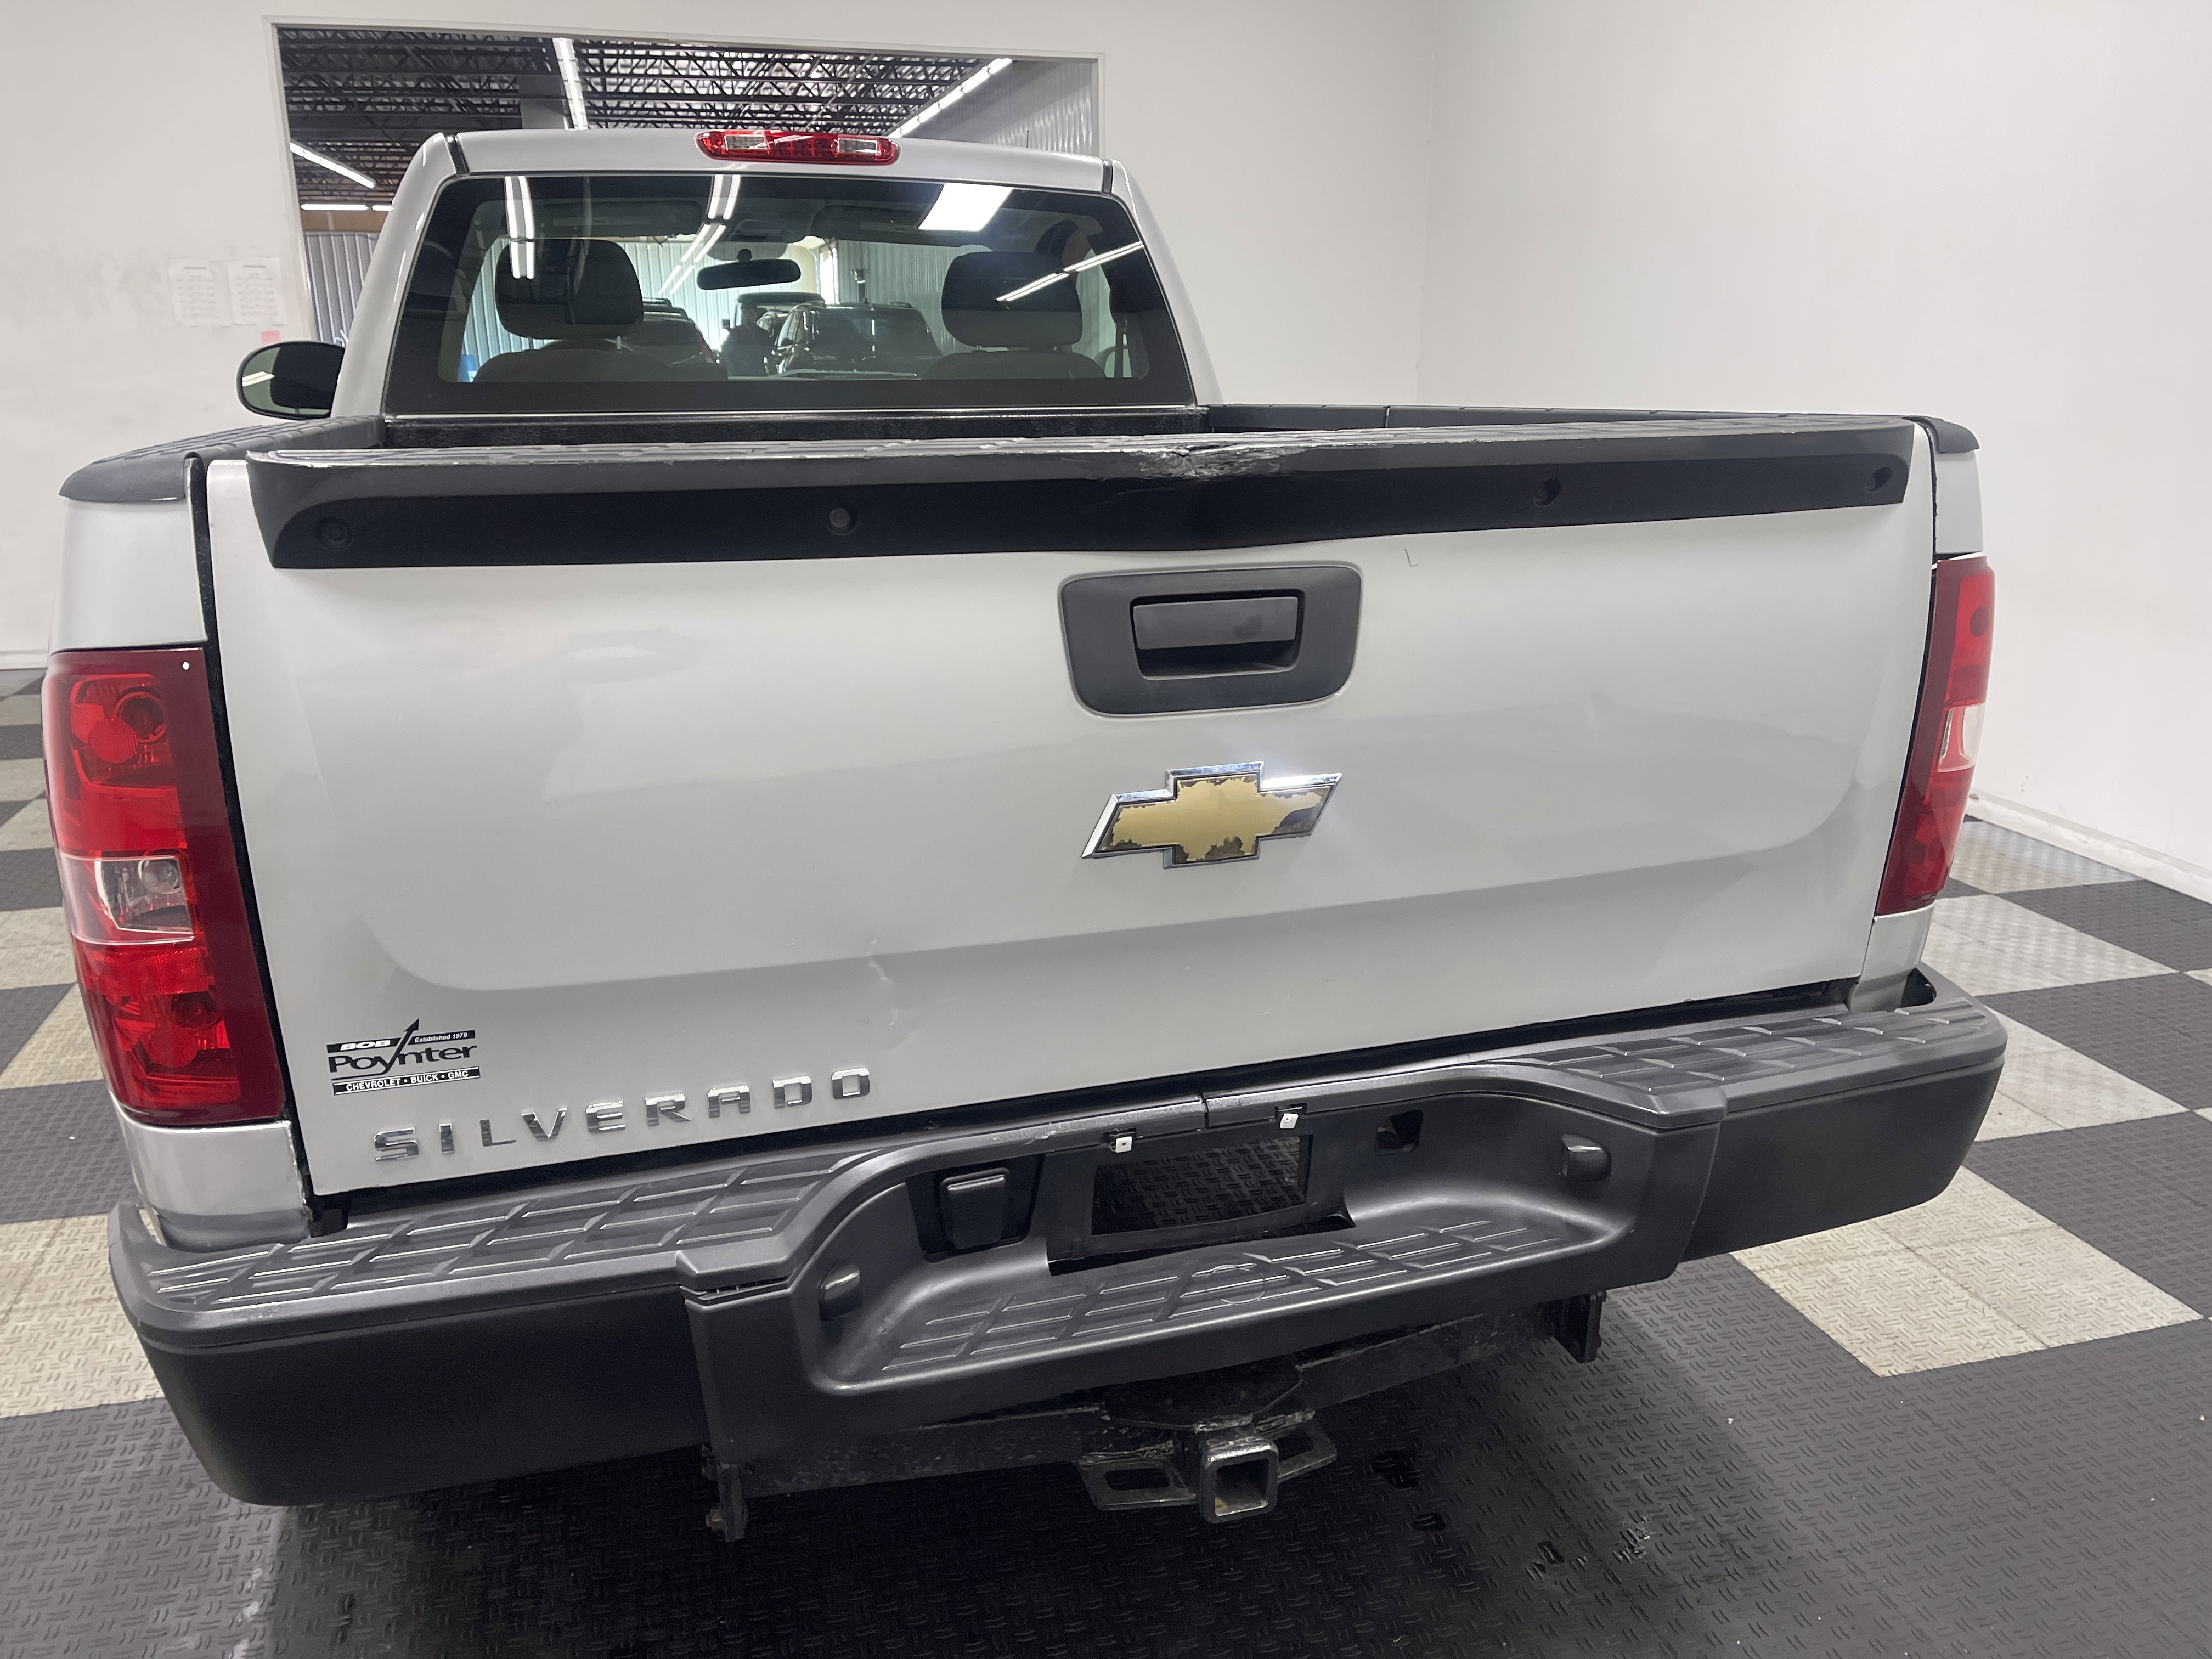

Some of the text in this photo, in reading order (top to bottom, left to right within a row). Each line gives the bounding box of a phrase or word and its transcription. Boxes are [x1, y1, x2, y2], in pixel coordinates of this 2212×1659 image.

[340, 1040, 391, 1051] BOB
[415, 1034, 450, 1043] Established
[328, 1039, 477, 1076] Poynter
[346, 1070, 469, 1092] CHEVROLET BUICK GMC
[374, 1066, 871, 1163] SILVERADO
